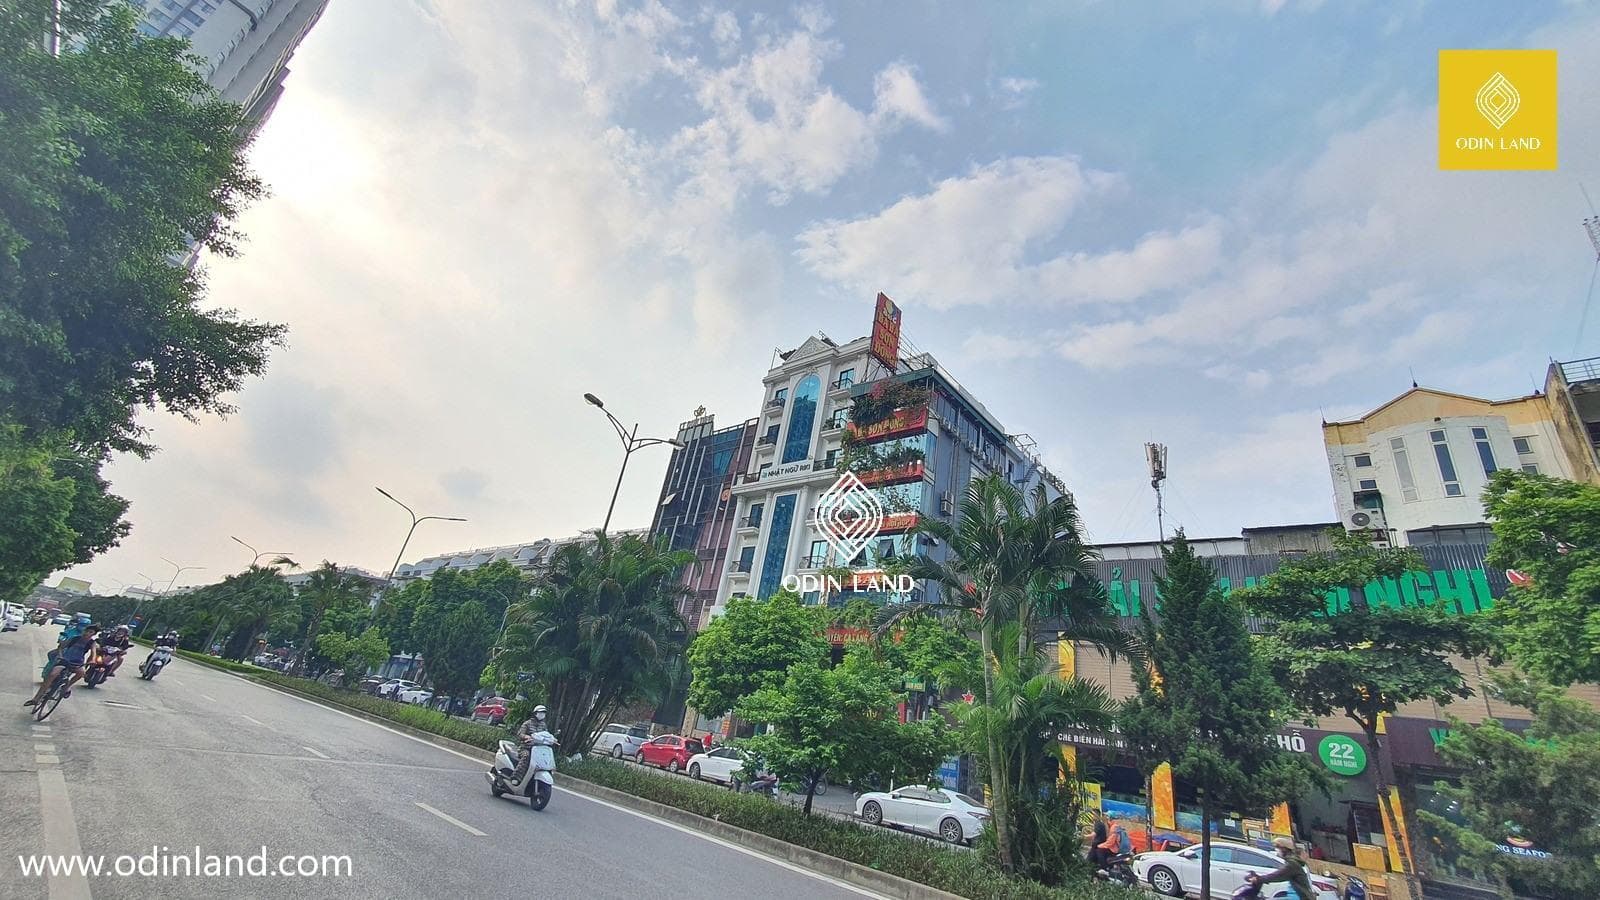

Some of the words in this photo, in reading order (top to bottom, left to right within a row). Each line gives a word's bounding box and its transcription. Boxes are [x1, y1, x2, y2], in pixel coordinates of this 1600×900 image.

[785, 464, 799, 474] NGỮ
[1364, 569, 1497, 616] NGHI
[1328, 742, 1356, 760] 22
